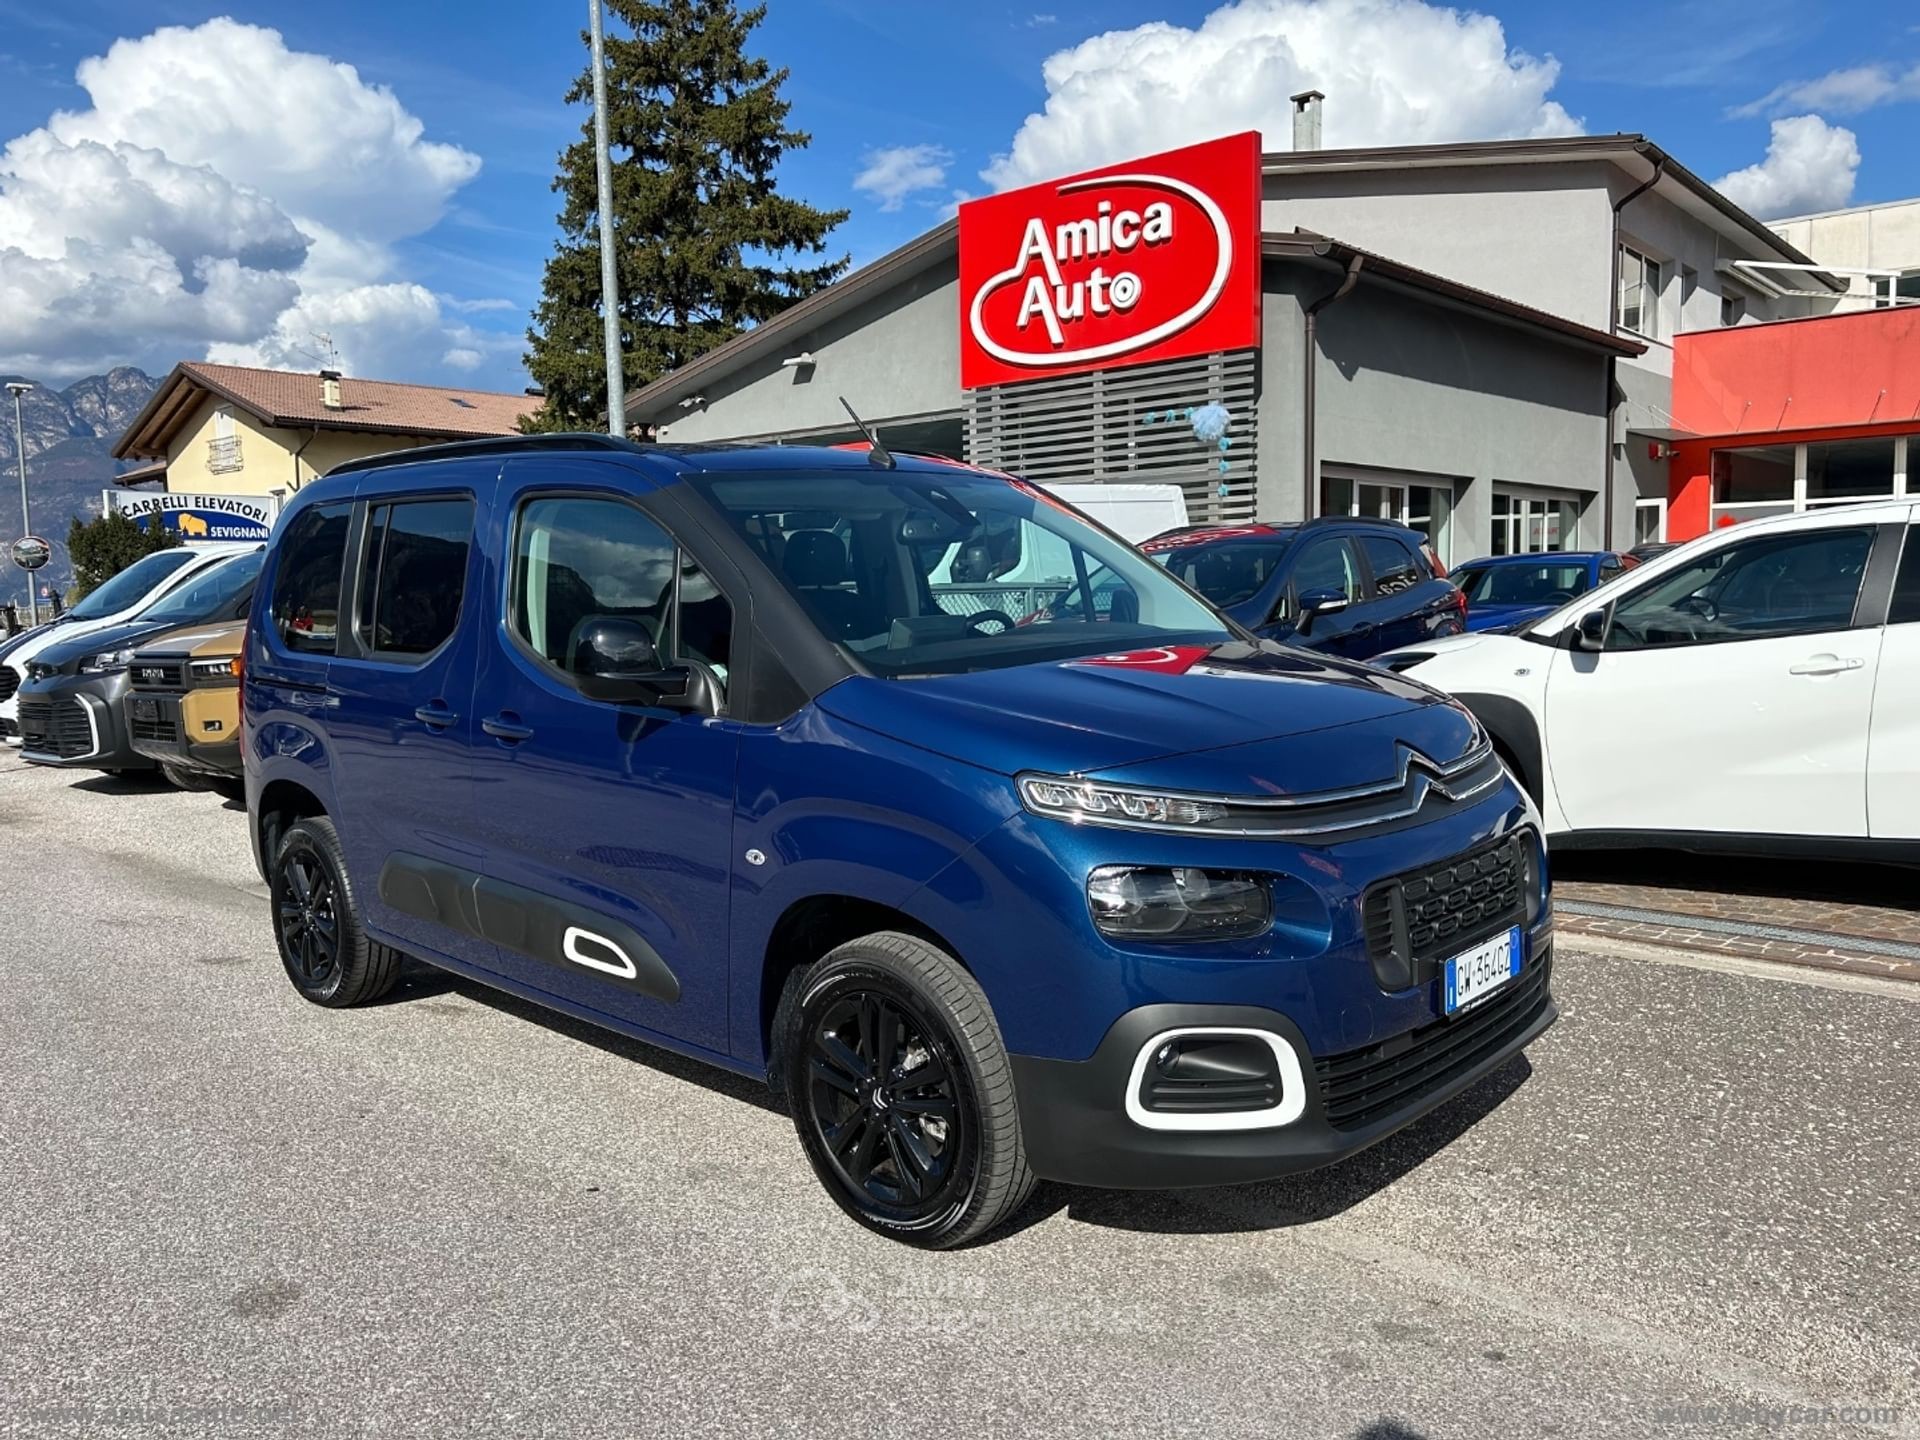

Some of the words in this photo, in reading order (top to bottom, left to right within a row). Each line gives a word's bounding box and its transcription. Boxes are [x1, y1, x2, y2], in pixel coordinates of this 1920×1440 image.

[1015, 200, 1174, 286] Amica
[1015, 267, 1142, 345] Auto
[122, 496, 188, 517] CARRELLI
[194, 496, 267, 522] ELEVATORI
[210, 526, 269, 539] SEVIGNANI
